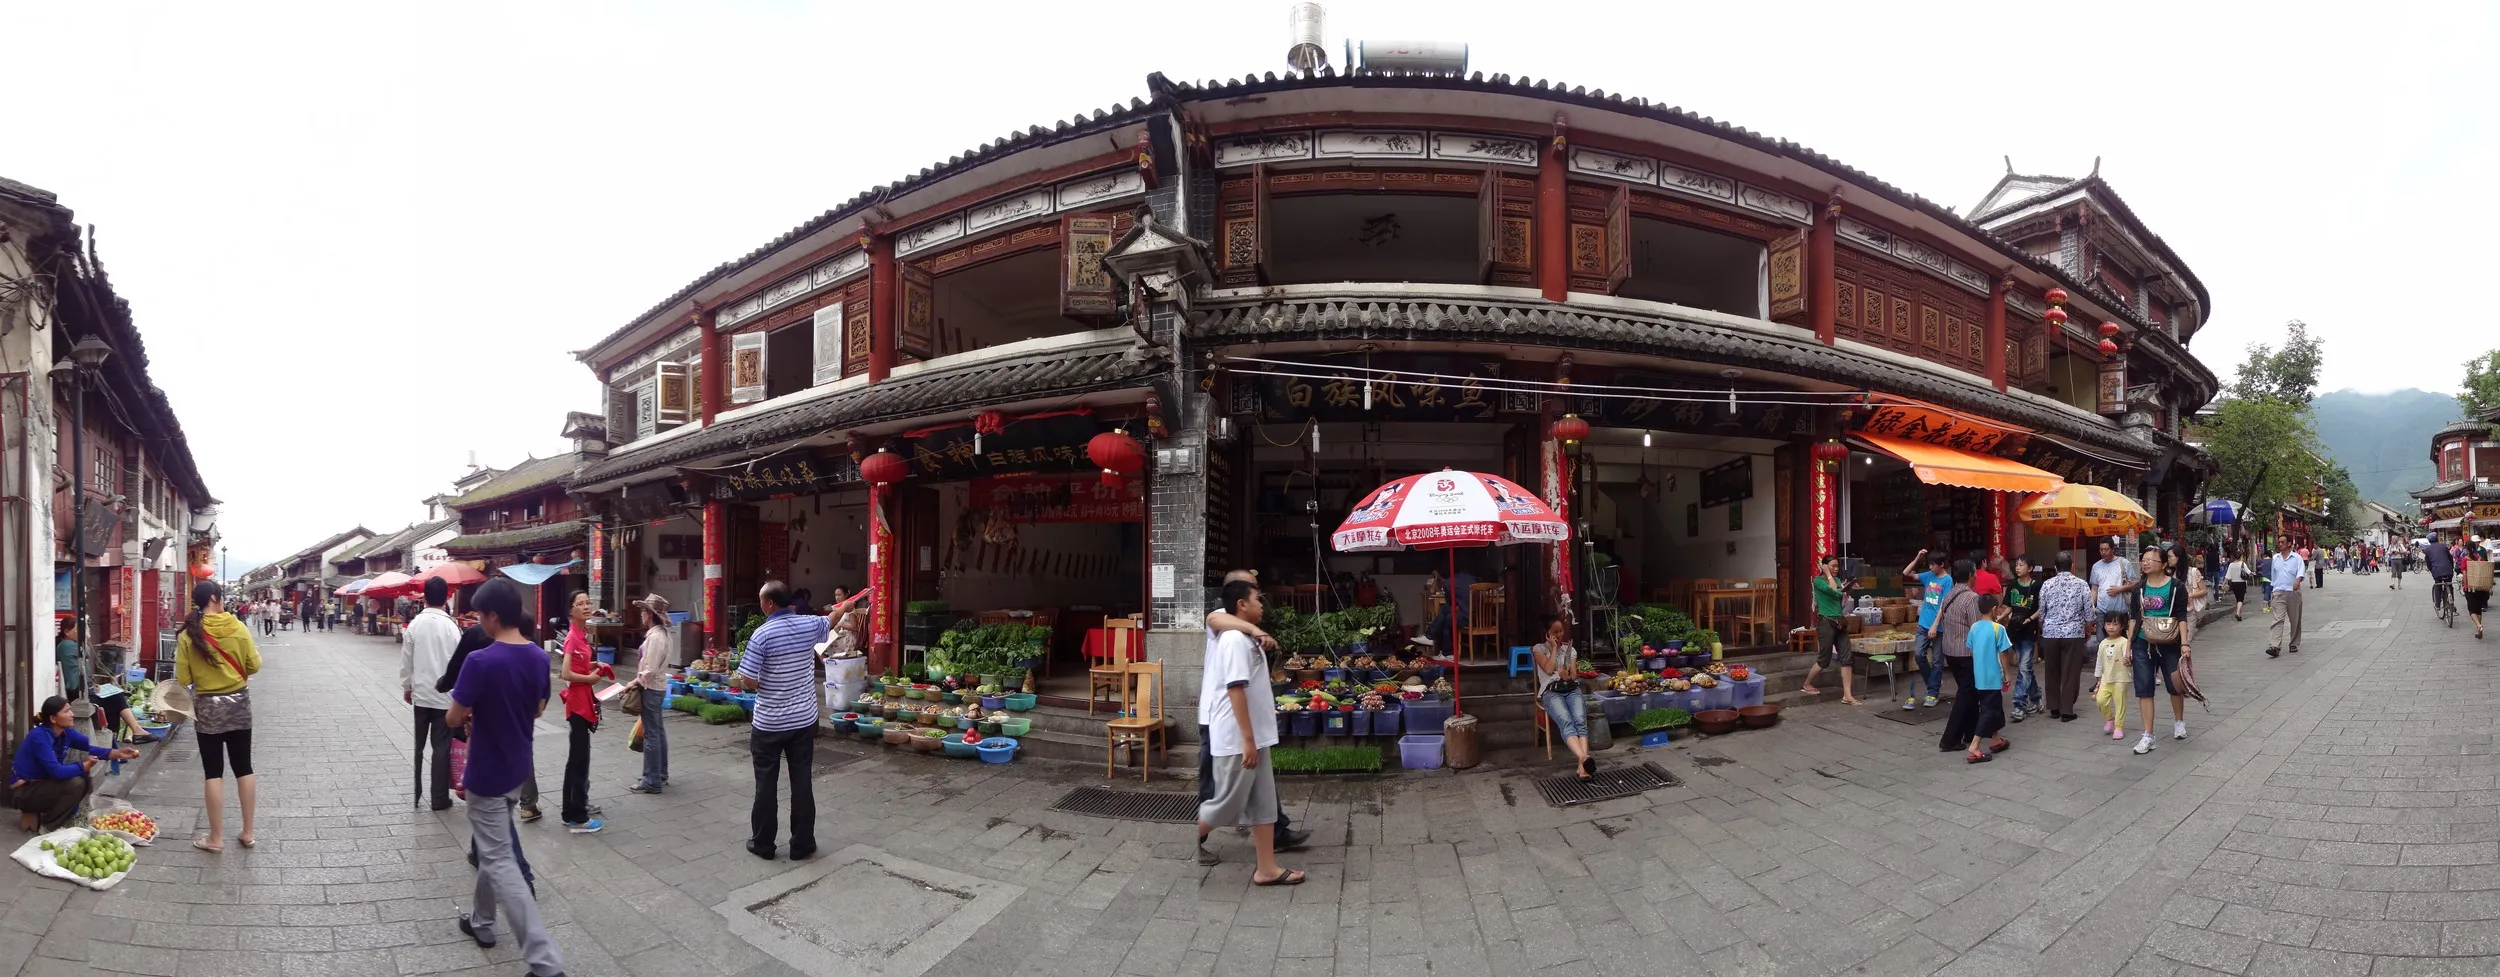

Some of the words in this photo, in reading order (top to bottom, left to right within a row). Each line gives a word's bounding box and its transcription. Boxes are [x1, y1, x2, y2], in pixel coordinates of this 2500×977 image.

[1404, 524, 1494, 540] 北京2008年奥运会正式摩托车
[1510, 522, 1560, 535] 大运摩托车
